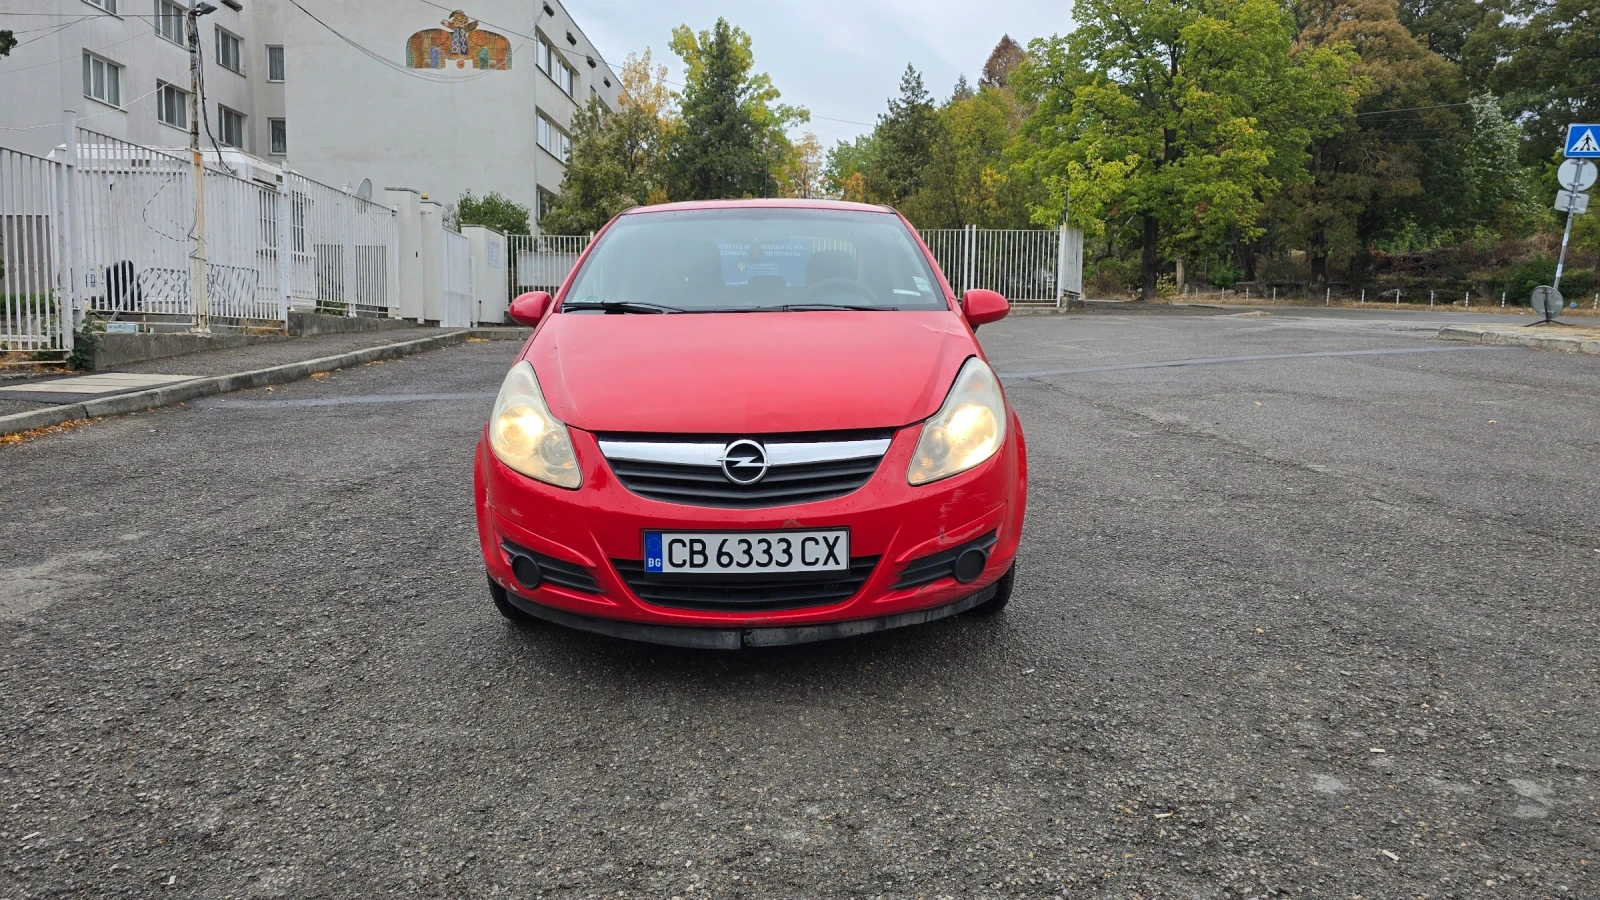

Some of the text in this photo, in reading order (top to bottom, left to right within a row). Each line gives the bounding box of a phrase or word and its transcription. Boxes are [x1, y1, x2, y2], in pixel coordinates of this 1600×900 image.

[668, 536, 841, 568] CB 6333 CX
[648, 558, 662, 567] BG
